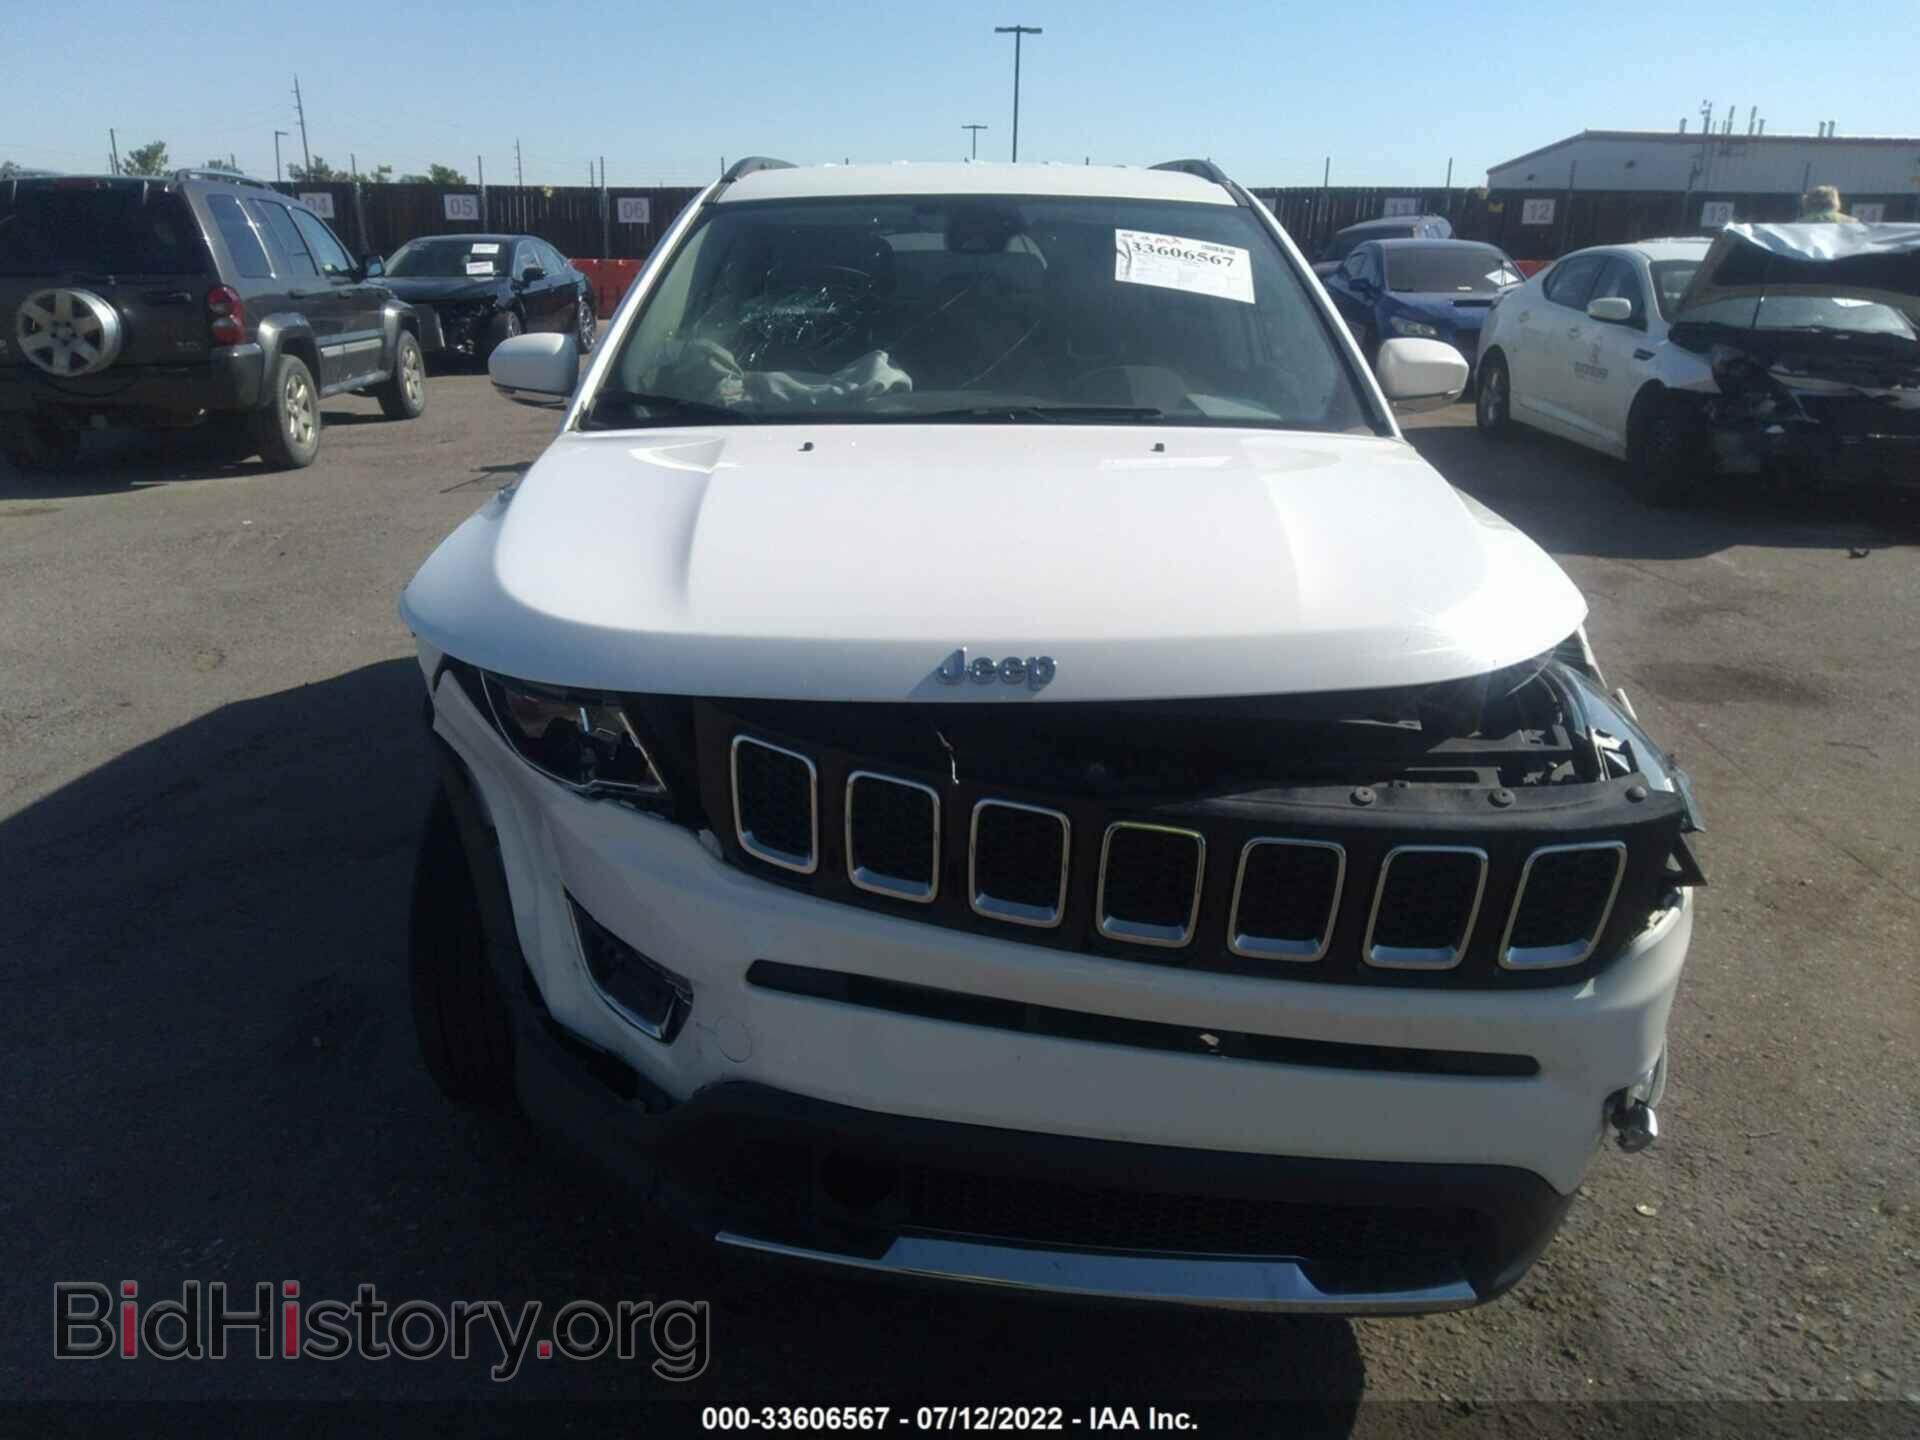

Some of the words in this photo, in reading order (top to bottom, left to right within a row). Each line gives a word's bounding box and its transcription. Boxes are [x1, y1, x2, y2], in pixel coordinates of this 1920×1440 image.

[449, 199, 473, 217] 05
[623, 201, 646, 219] 06
[1529, 202, 1552, 221] 12
[1711, 204, 1730, 223] 13
[1131, 241, 1235, 268] 33606567
[936, 647, 1057, 692] Jeep
